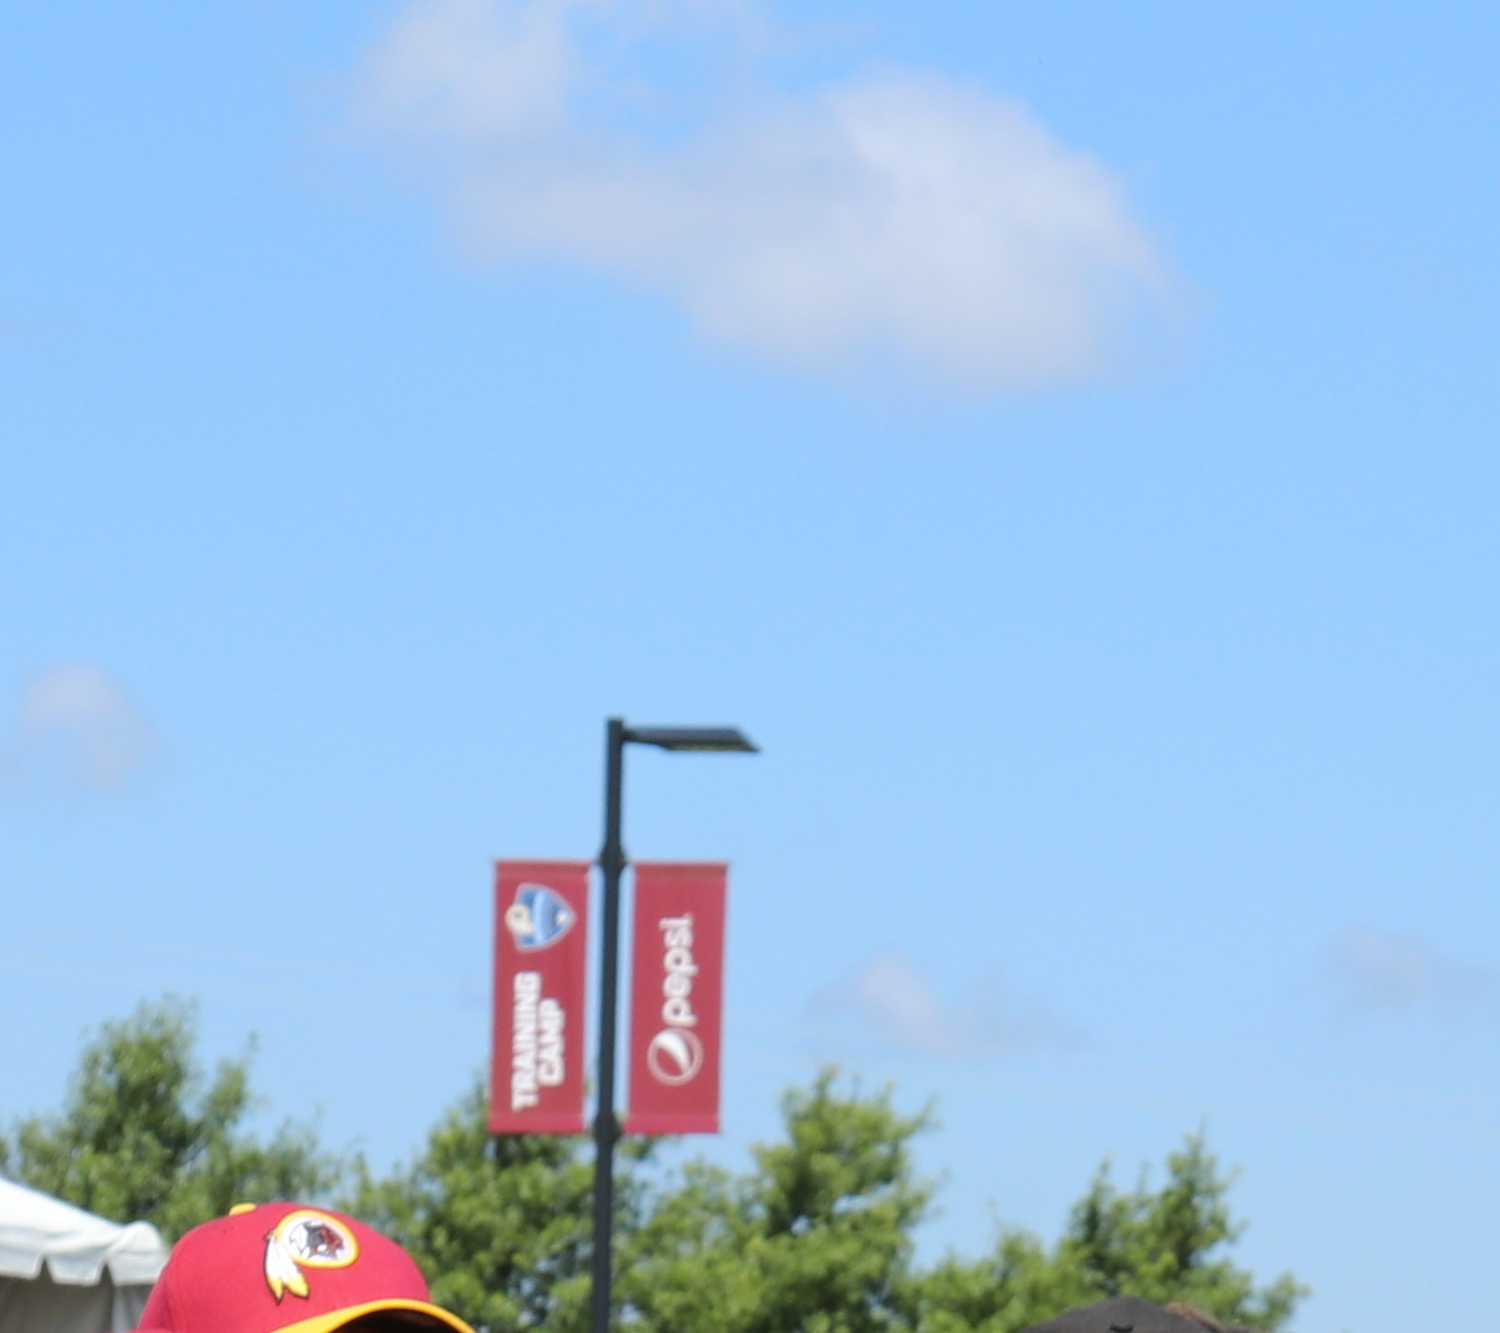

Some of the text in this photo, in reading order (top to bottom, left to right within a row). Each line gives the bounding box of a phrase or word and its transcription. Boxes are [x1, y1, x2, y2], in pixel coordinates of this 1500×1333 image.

[659, 917, 698, 1027] pepsi
[512, 971, 541, 1112] TRAINING
[538, 998, 566, 1087] CAMP
